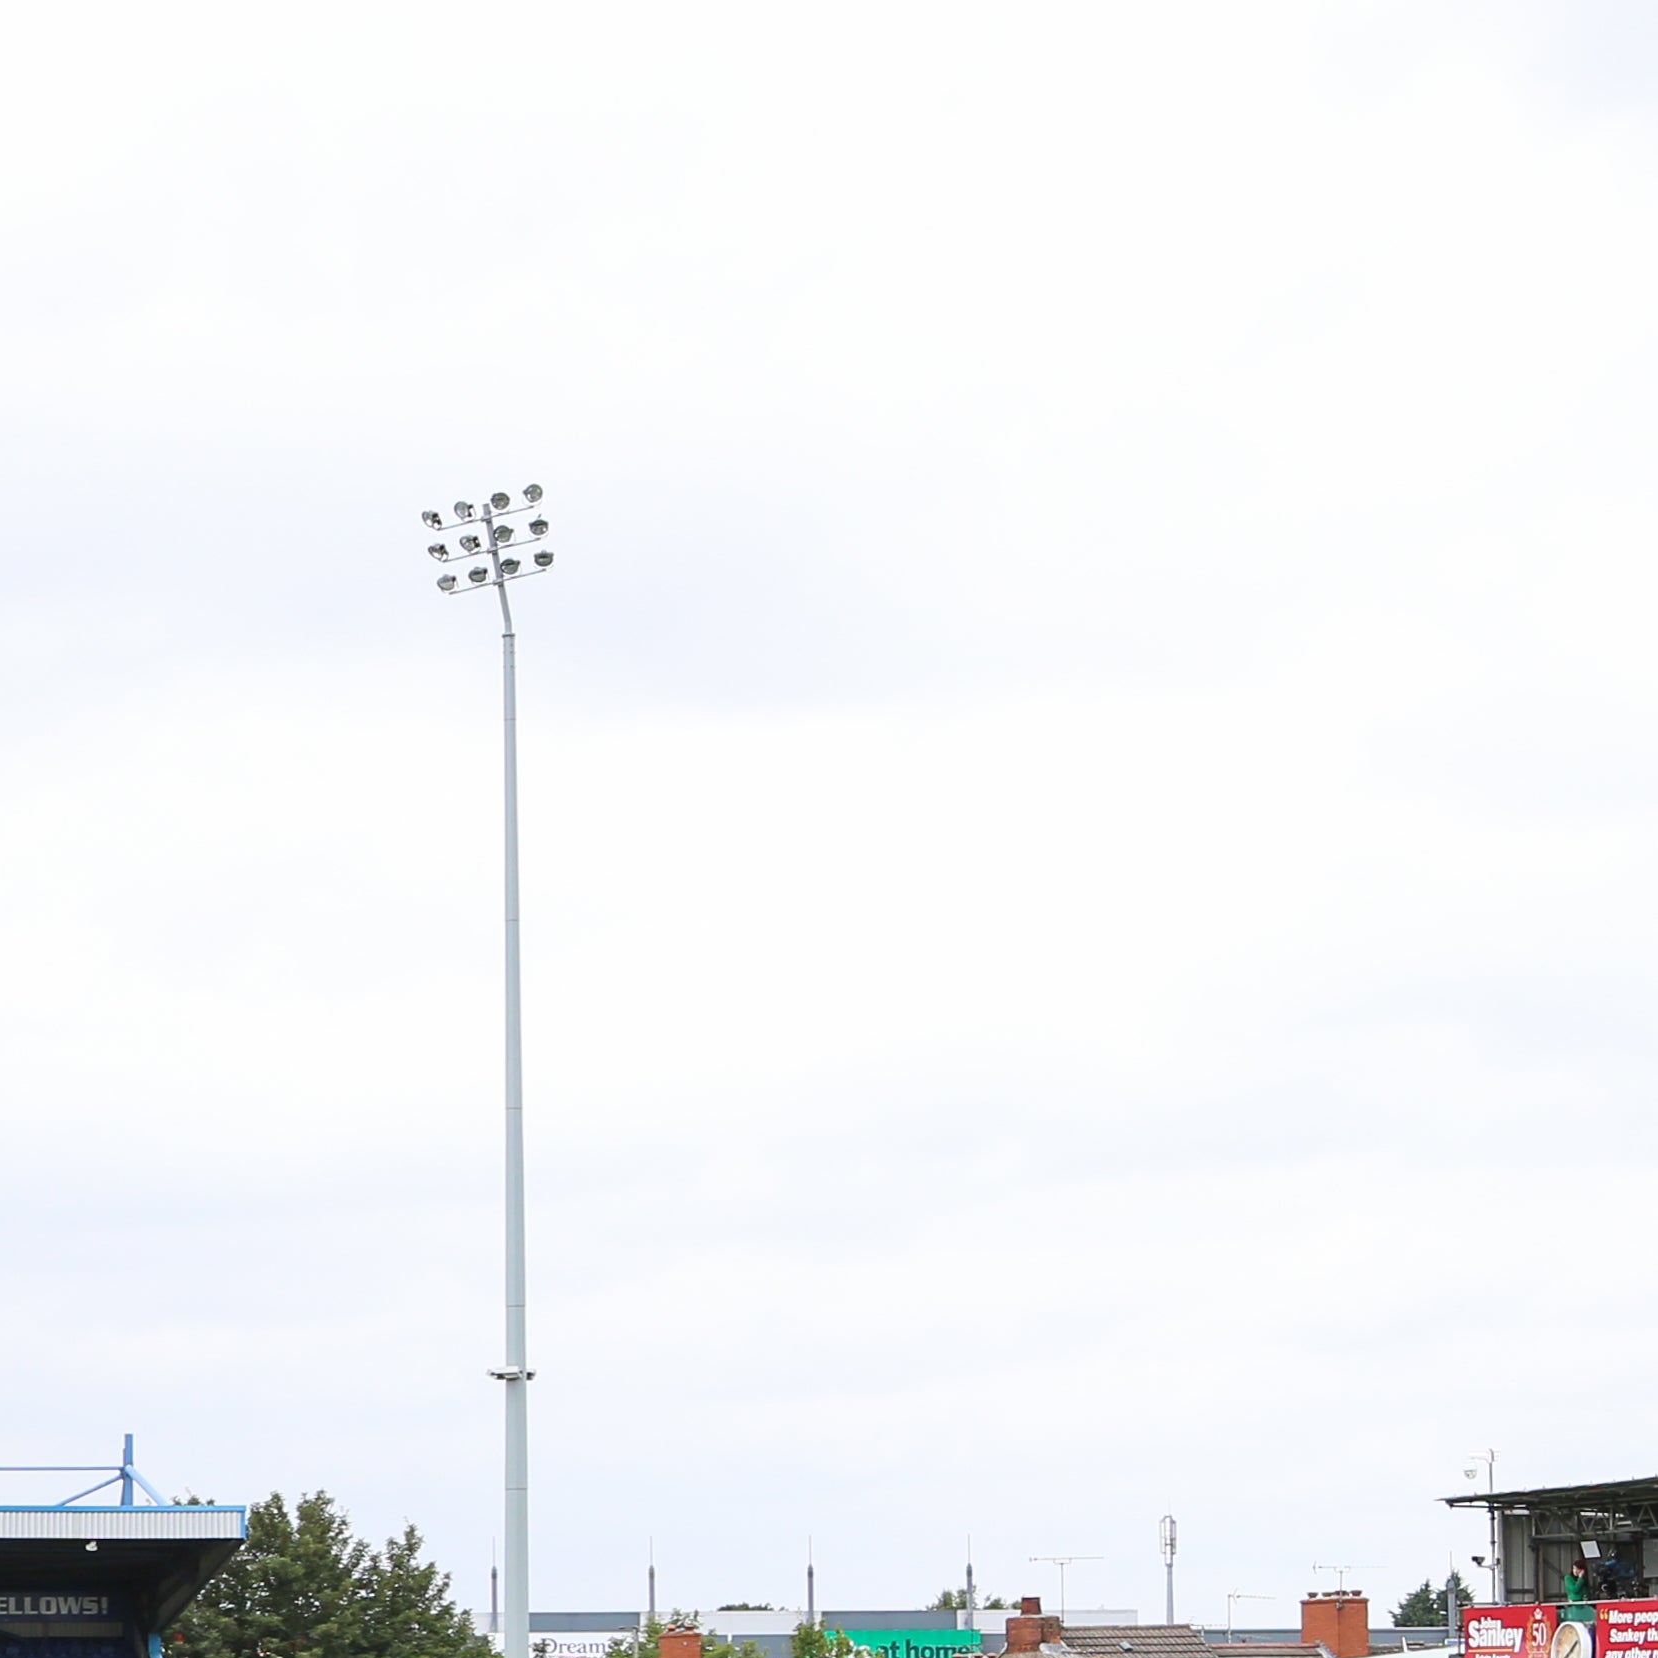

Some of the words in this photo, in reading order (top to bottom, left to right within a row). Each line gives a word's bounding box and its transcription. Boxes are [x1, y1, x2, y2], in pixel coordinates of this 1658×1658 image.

[1468, 1620, 1524, 1653] Sankey
[1532, 1623, 1547, 1646] 50
[1609, 1629, 1646, 1645] Sankey
